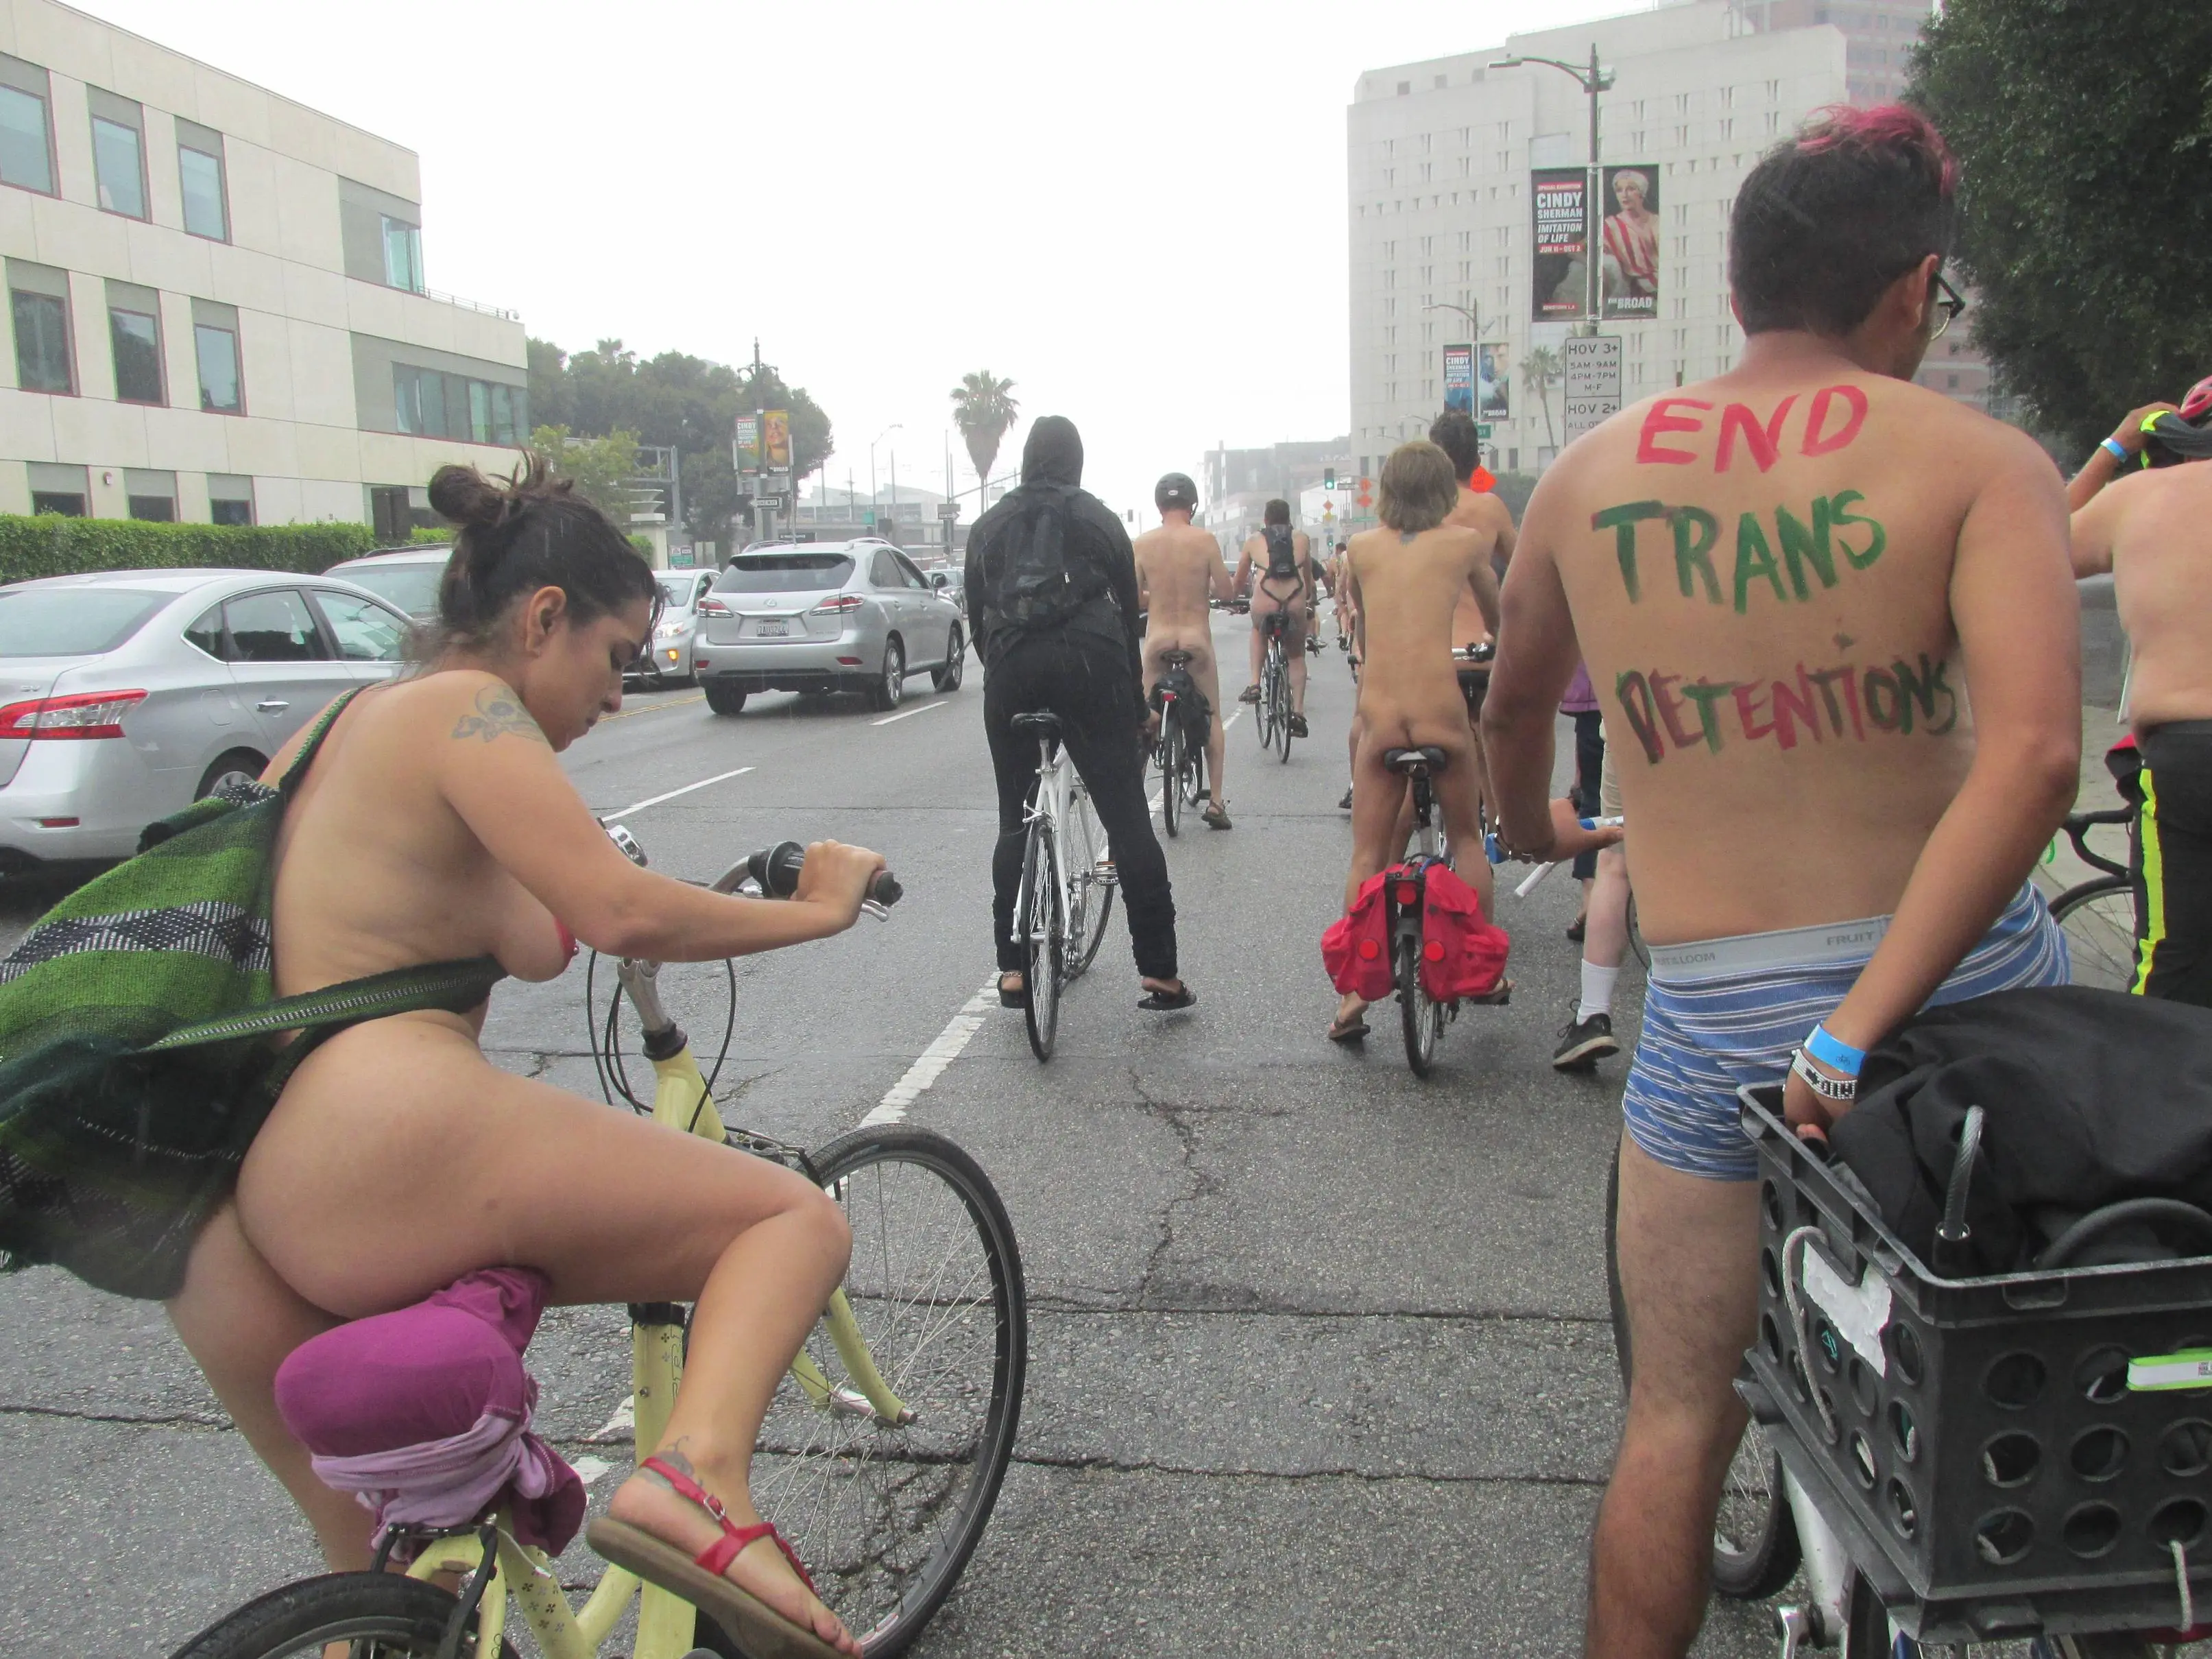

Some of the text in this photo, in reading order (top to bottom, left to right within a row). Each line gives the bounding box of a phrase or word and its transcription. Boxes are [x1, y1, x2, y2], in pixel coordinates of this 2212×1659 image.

[1537, 192, 1582, 208] CINDY
[1537, 208, 1583, 219] SHERMAN
[1538, 222, 1582, 233] IMITATION
[1538, 233, 1569, 243] OF LIFE
[1618, 297, 1652, 309] BROAD
[1568, 343, 1618, 355] HOV 3+
[1446, 357, 1469, 365] CINDY
[1568, 403, 1618, 415] HOV 2+
[1635, 384, 1868, 473] END
[1591, 489, 1886, 614] TRANS
[1615, 652, 1957, 765] DETENTIONS
[1827, 931, 1876, 946] FRUIT
